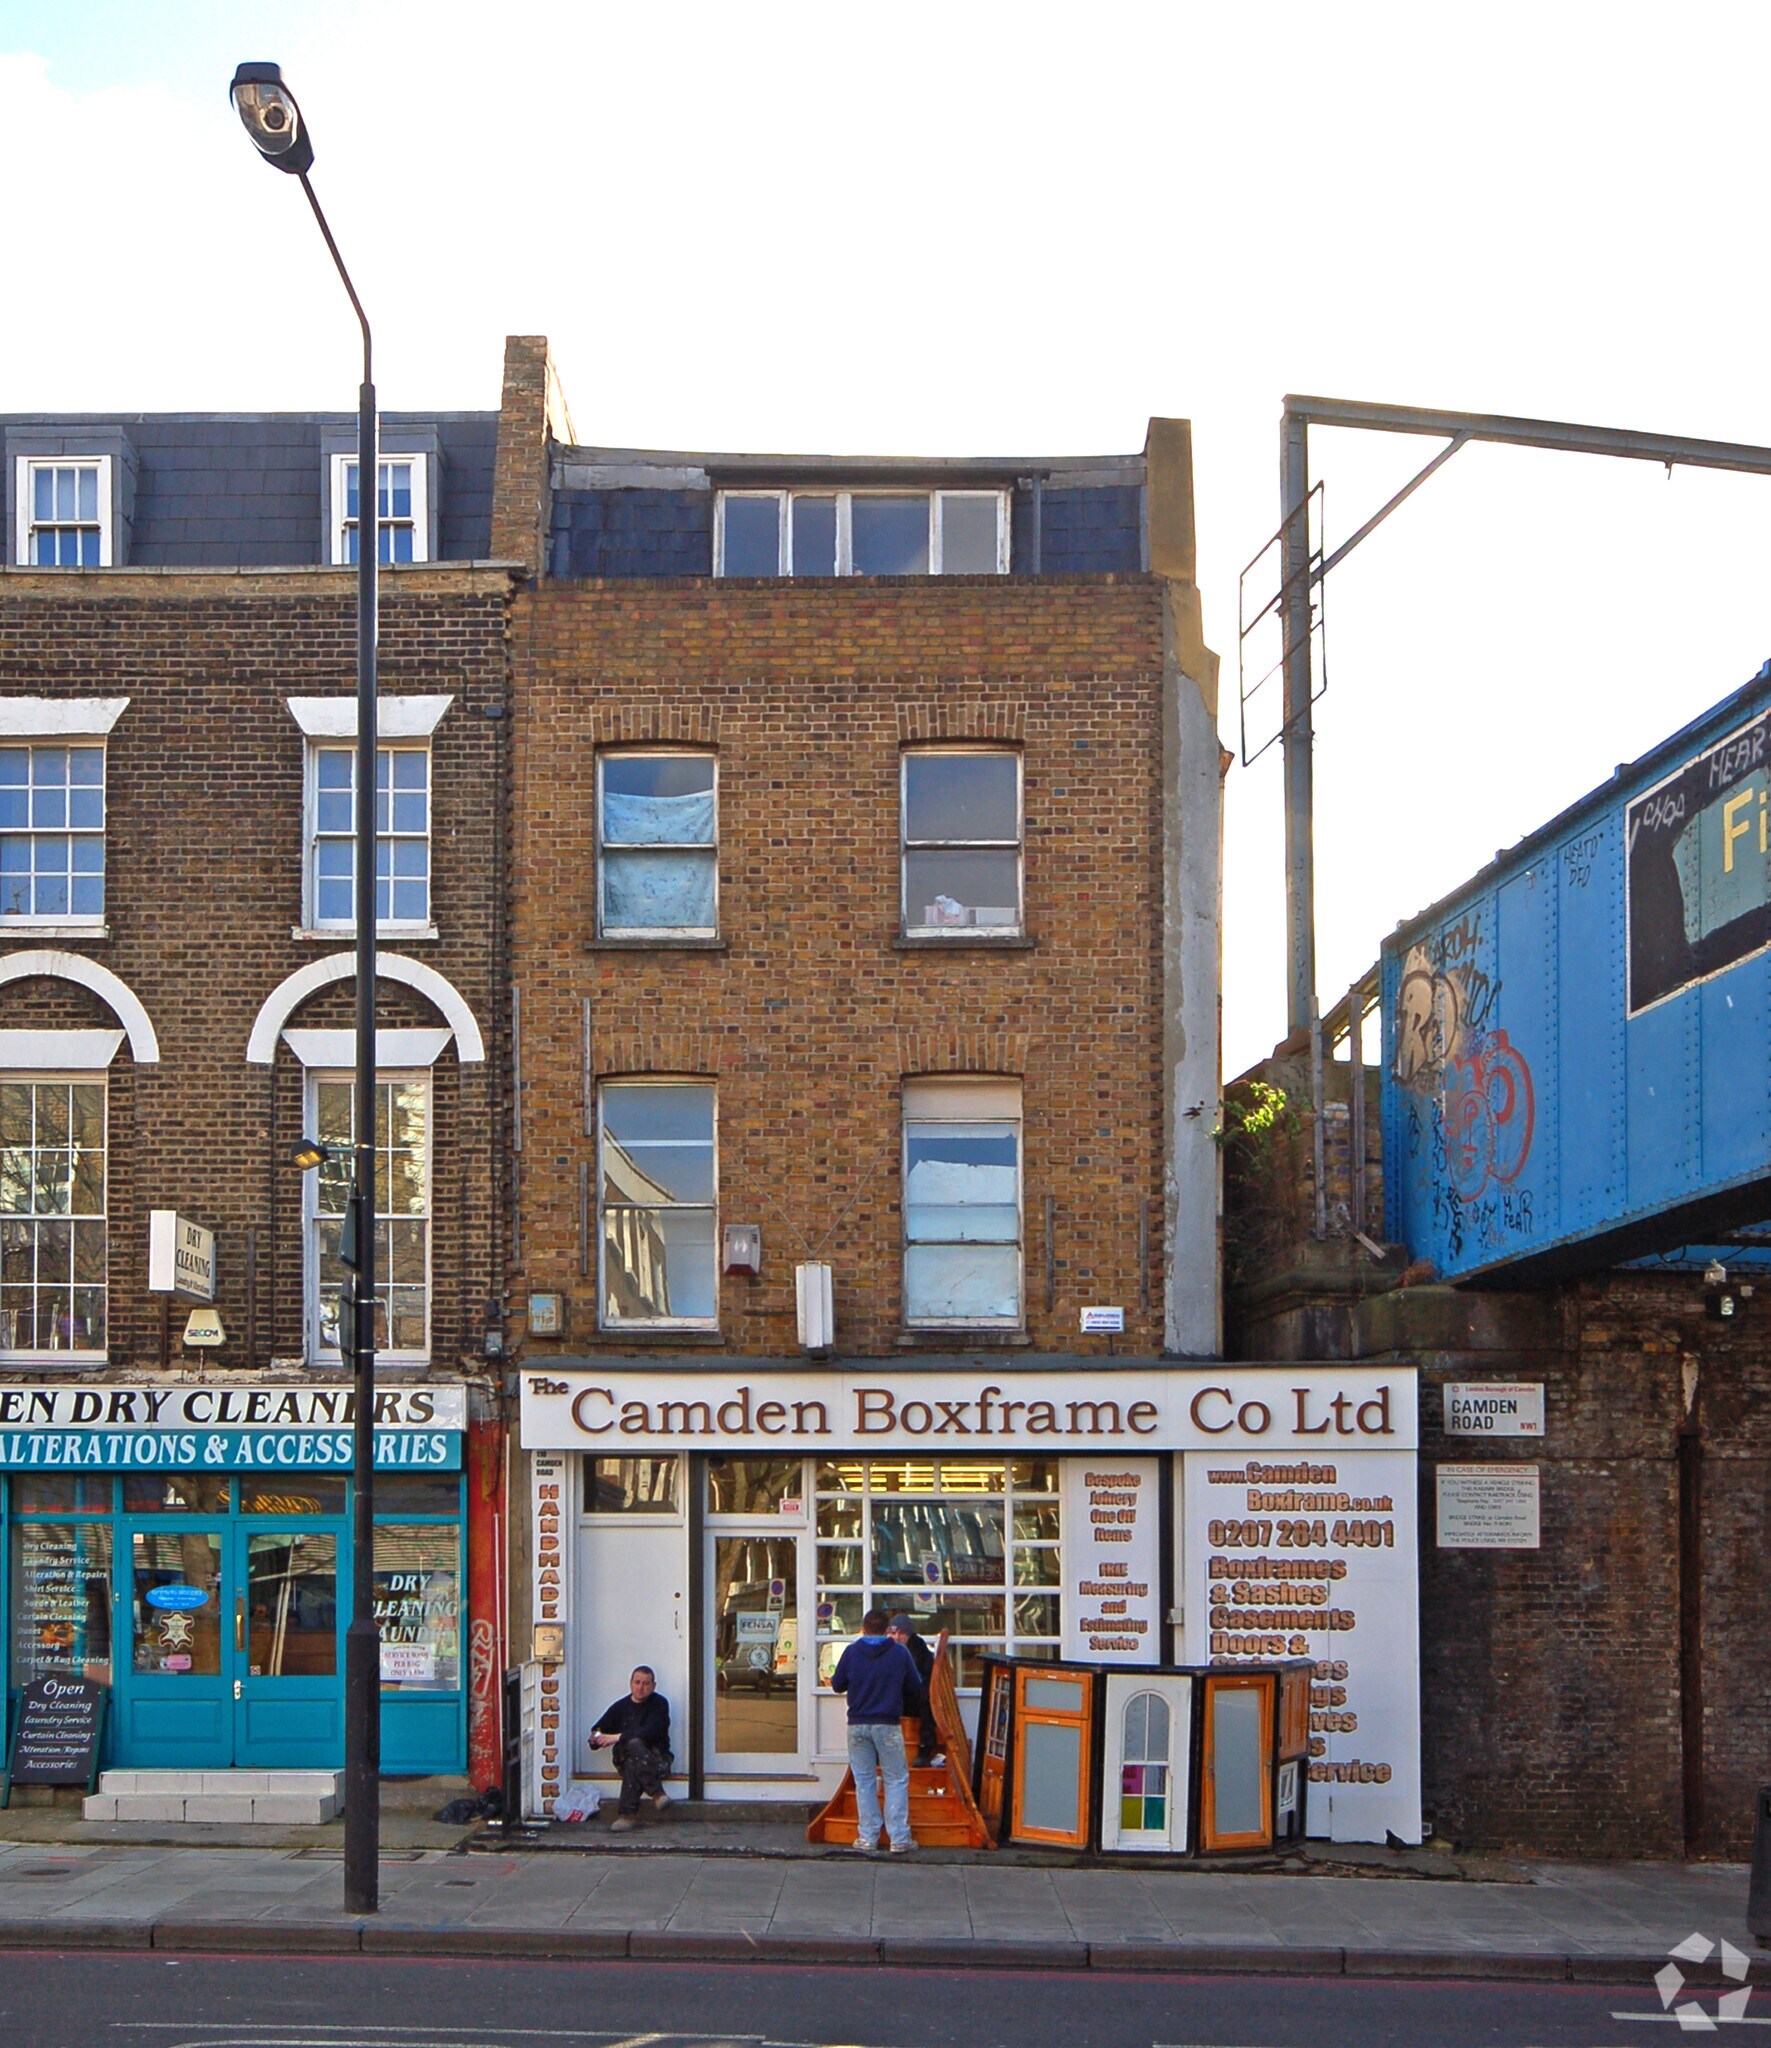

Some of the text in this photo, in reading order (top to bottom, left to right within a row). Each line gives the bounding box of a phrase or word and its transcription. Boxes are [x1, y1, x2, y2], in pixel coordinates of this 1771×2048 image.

[186, 1227, 202, 1249] DRY
[176, 1249, 211, 1279] CLEANING
[188, 1329, 219, 1338] SECOM
[0, 1391, 60, 1424] EN
[69, 1391, 174, 1424] DRY
[528, 1377, 1395, 1436] The Camden Boxframe Co Ltd
[1451, 1399, 1517, 1414] CAMDEN
[1451, 1416, 1537, 1431] ROAD NW1
[203, 1434, 229, 1465] &
[234, 1434, 447, 1465] ACCESSRIES
[1085, 1472, 1142, 1488] Bespoke
[1089, 1491, 1137, 1507] Joinery
[1247, 1489, 1393, 1512] Boxframe.co.uk
[1090, 1509, 1136, 1524] One Off
[1094, 1527, 1133, 1542] Items
[1208, 1519, 1394, 1547] 0207 284 4401
[40, 1542, 77, 1552] Cleaning
[538, 1484, 560, 1619] HANDMADE
[60, 1556, 90, 1565] Service
[1208, 1556, 1347, 1580] Boxframes
[67, 1571, 74, 1579] &
[75, 1571, 108, 1580] Repairs
[1099, 1562, 1128, 1577] FREE
[23, 1585, 75, 1593] Shirt Service
[390, 1575, 432, 1591] DRY
[1079, 1581, 1148, 1597] Measuring
[1209, 1581, 1328, 1605] & Sashes
[24, 1599, 90, 1608] Suede & Leather
[373, 1600, 458, 1617] LEANING
[1101, 1599, 1126, 1614] and
[17, 1613, 87, 1622] Curtain Cleaning
[1210, 1605, 1356, 1631] Casements
[1079, 1618, 1148, 1634] Estimating
[1089, 1636, 1139, 1651] Service
[1210, 1631, 1310, 1655] Doors &
[16, 1657, 109, 1666] Carpet & Rug Cleaning
[43, 1679, 85, 1699] Open
[28, 1701, 92, 1713] Dry Cleaning
[24, 1716, 92, 1727] Laundry Service
[22, 1731, 91, 1742] Curtain Cleaning
[541, 1663, 560, 1815] FURNITURE
[24, 1760, 78, 1769] Accessories
[1308, 1759, 1392, 1783] ervice
